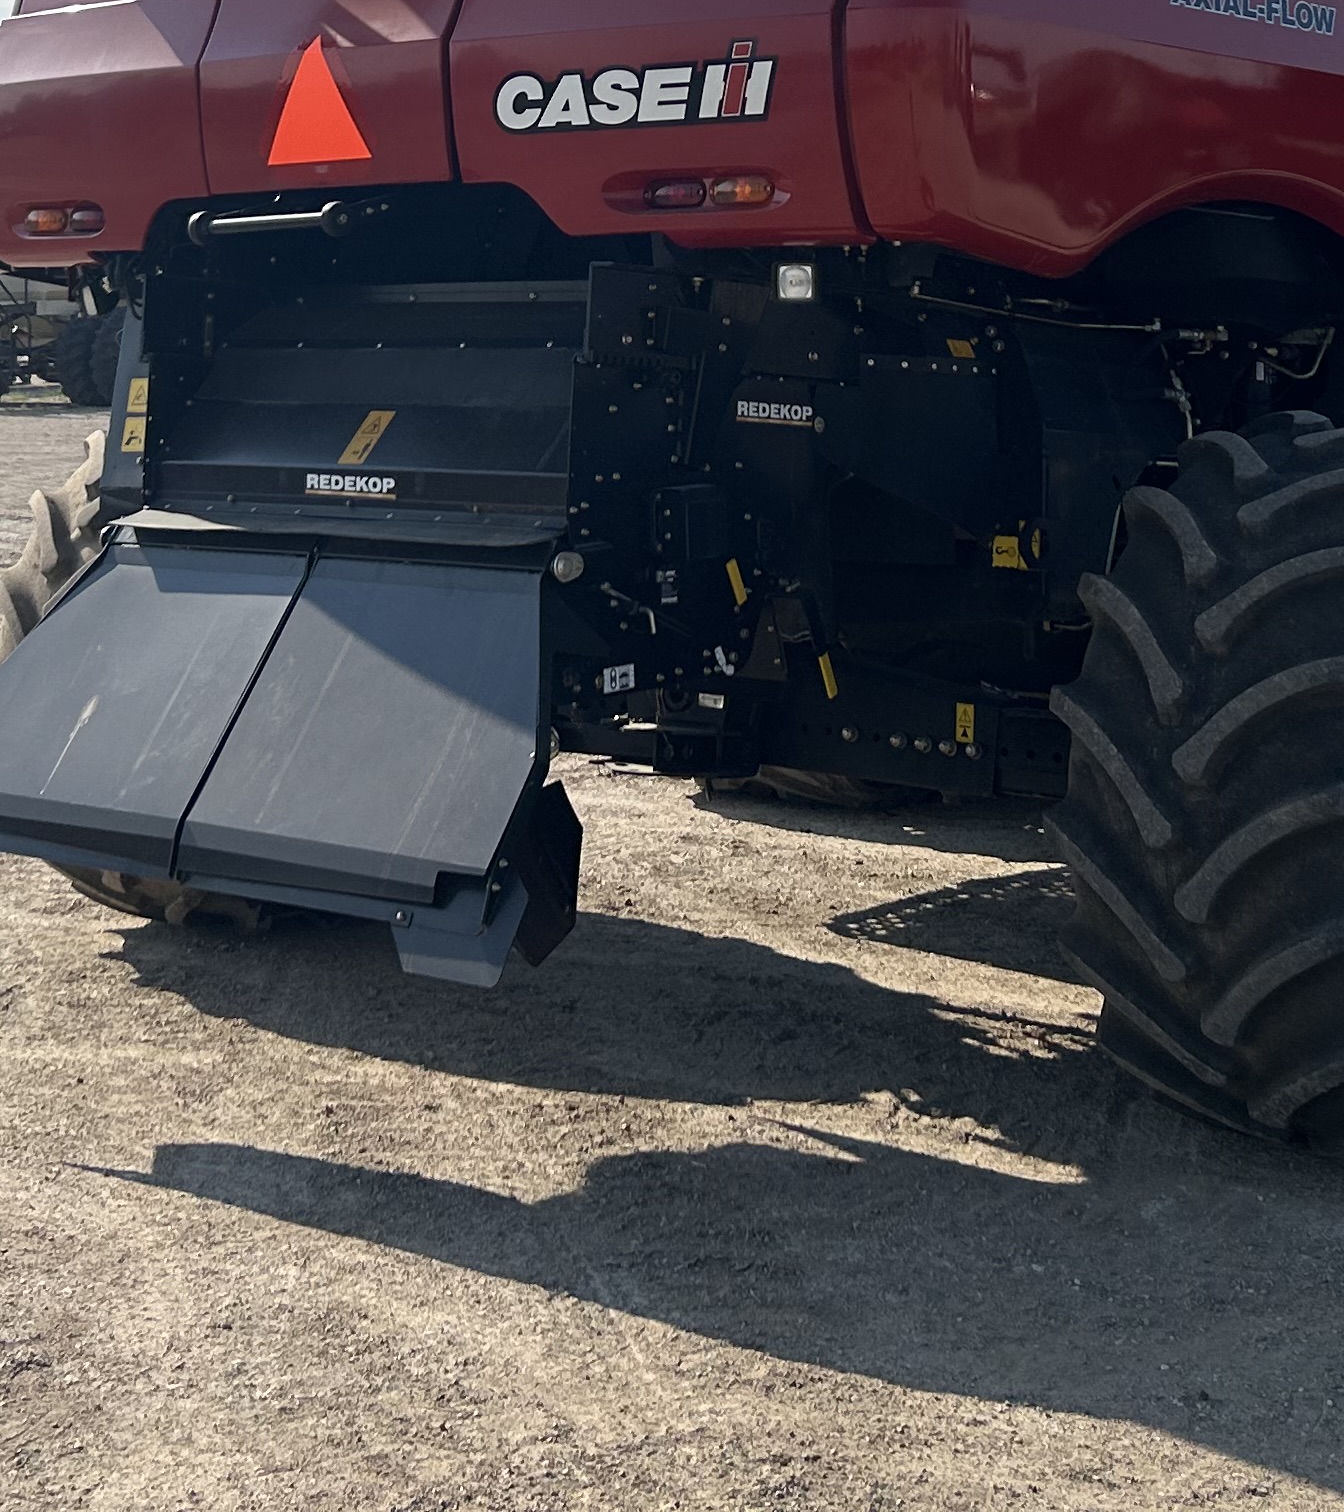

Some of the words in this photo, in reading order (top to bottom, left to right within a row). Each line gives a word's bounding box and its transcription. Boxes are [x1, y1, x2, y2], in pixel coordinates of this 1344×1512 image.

[496, 68, 693, 130] CASE
[737, 400, 813, 421] REDEKOP
[306, 473, 396, 494] REDEKOP
